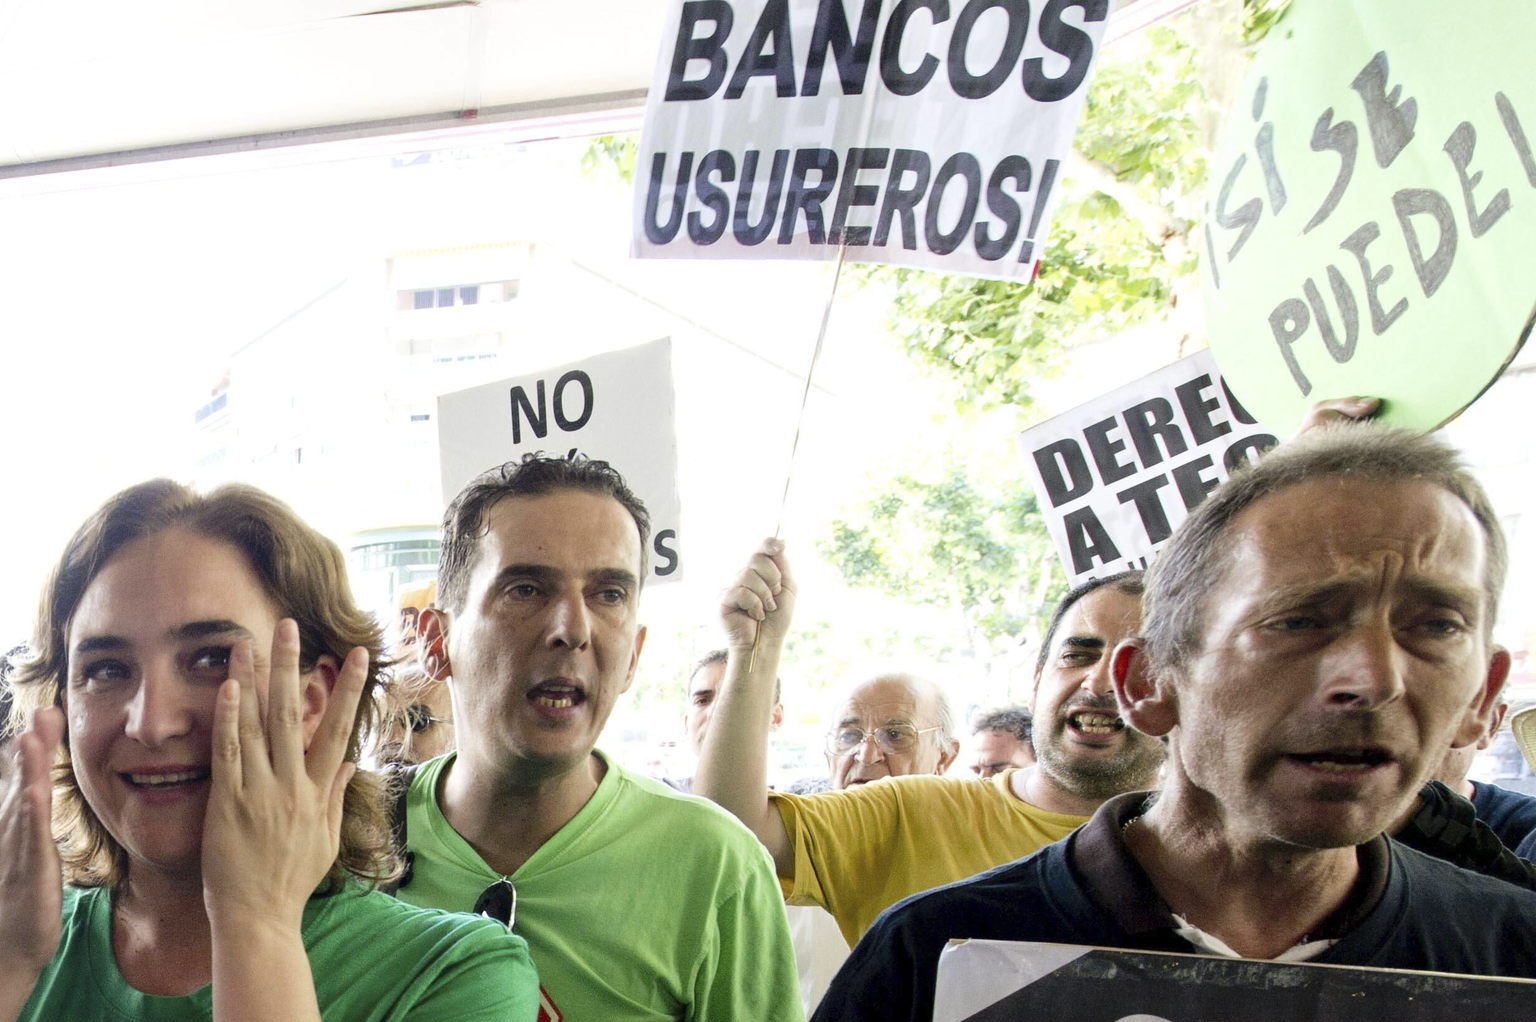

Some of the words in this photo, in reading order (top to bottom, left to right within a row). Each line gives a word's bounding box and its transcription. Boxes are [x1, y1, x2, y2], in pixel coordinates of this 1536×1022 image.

[665, 0, 1109, 102] BANCOS
[1297, 50, 1419, 235] SE
[644, 148, 1060, 264] USUREROS!
[510, 370, 594, 444] NO
[1032, 373, 1259, 508] DERE
[1063, 504, 1122, 576] A
